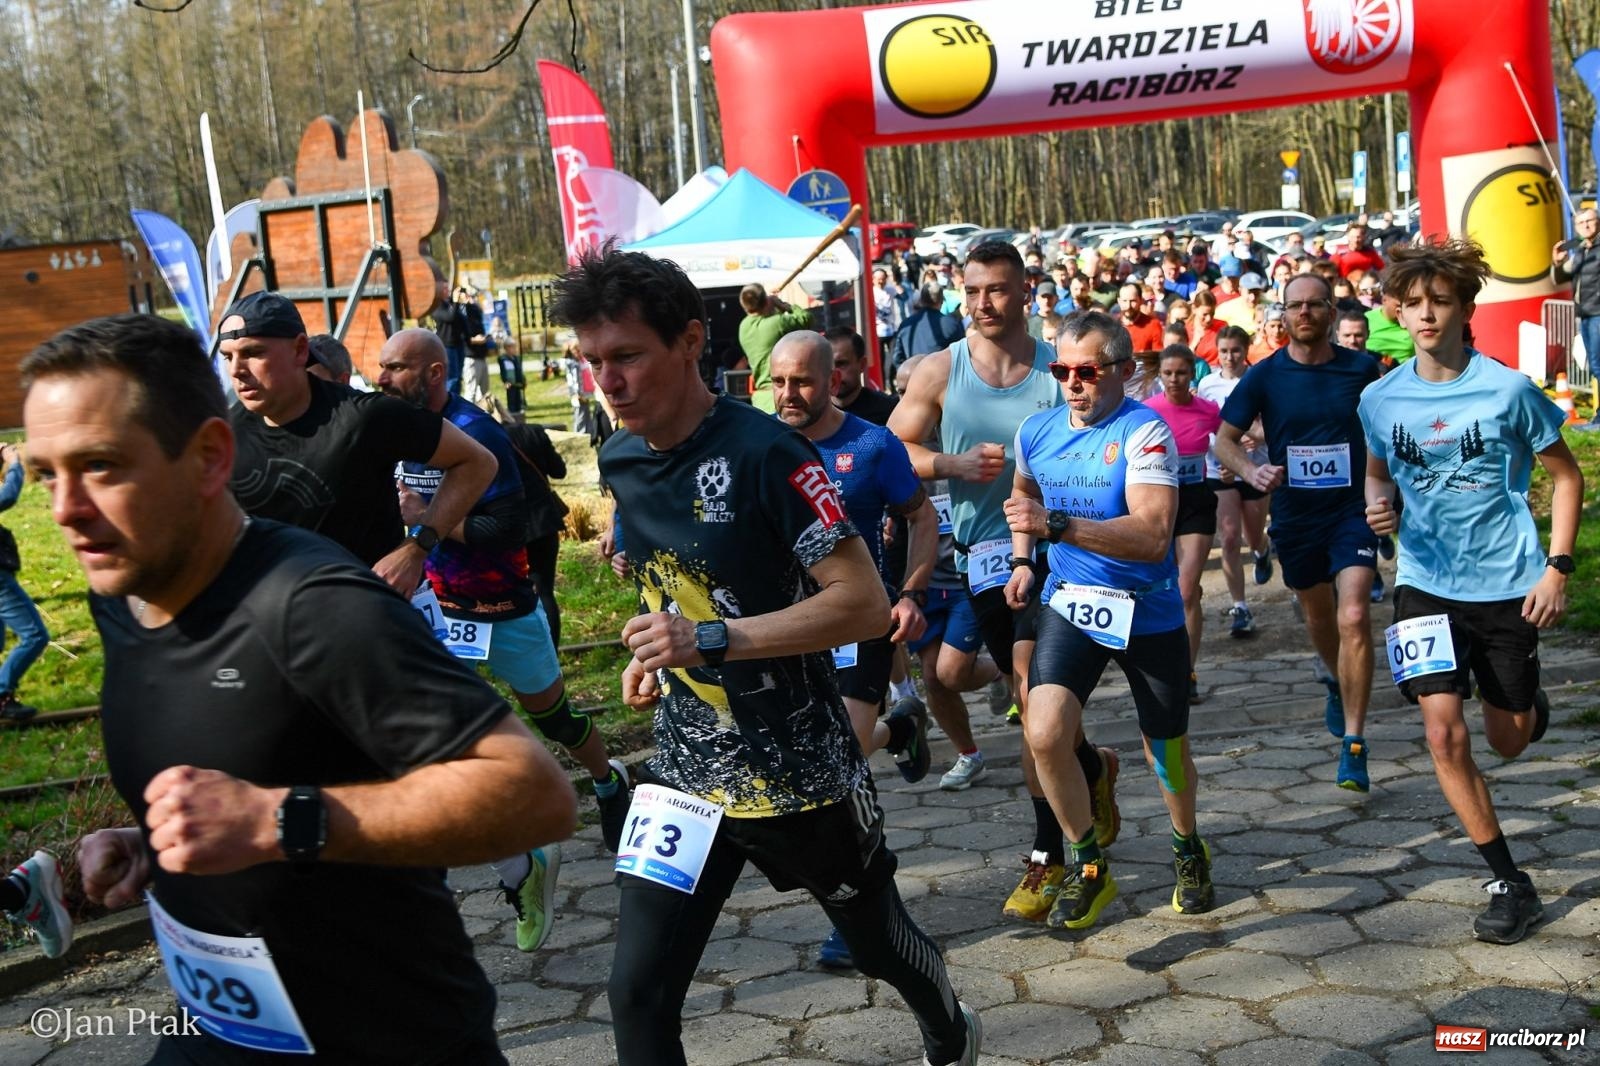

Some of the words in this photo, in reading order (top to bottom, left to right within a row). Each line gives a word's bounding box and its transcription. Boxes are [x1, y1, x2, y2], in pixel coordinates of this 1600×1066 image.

[1094, 0, 1182, 18] BIEG
[1022, 19, 1269, 68] TWARDZIELA
[1048, 63, 1245, 107] RACIBÓRZ
[1300, 460, 1337, 476] 104
[1039, 473, 1070, 490] Zajazd
[1072, 475, 1112, 488] Malibu
[1050, 496, 1095, 508] TEAM
[980, 551, 1014, 576] 129
[1067, 601, 1112, 629] 130
[449, 623, 477, 642] 58
[1394, 636, 1435, 666] 007
[626, 815, 682, 858] 123
[174, 954, 260, 1020] 029
